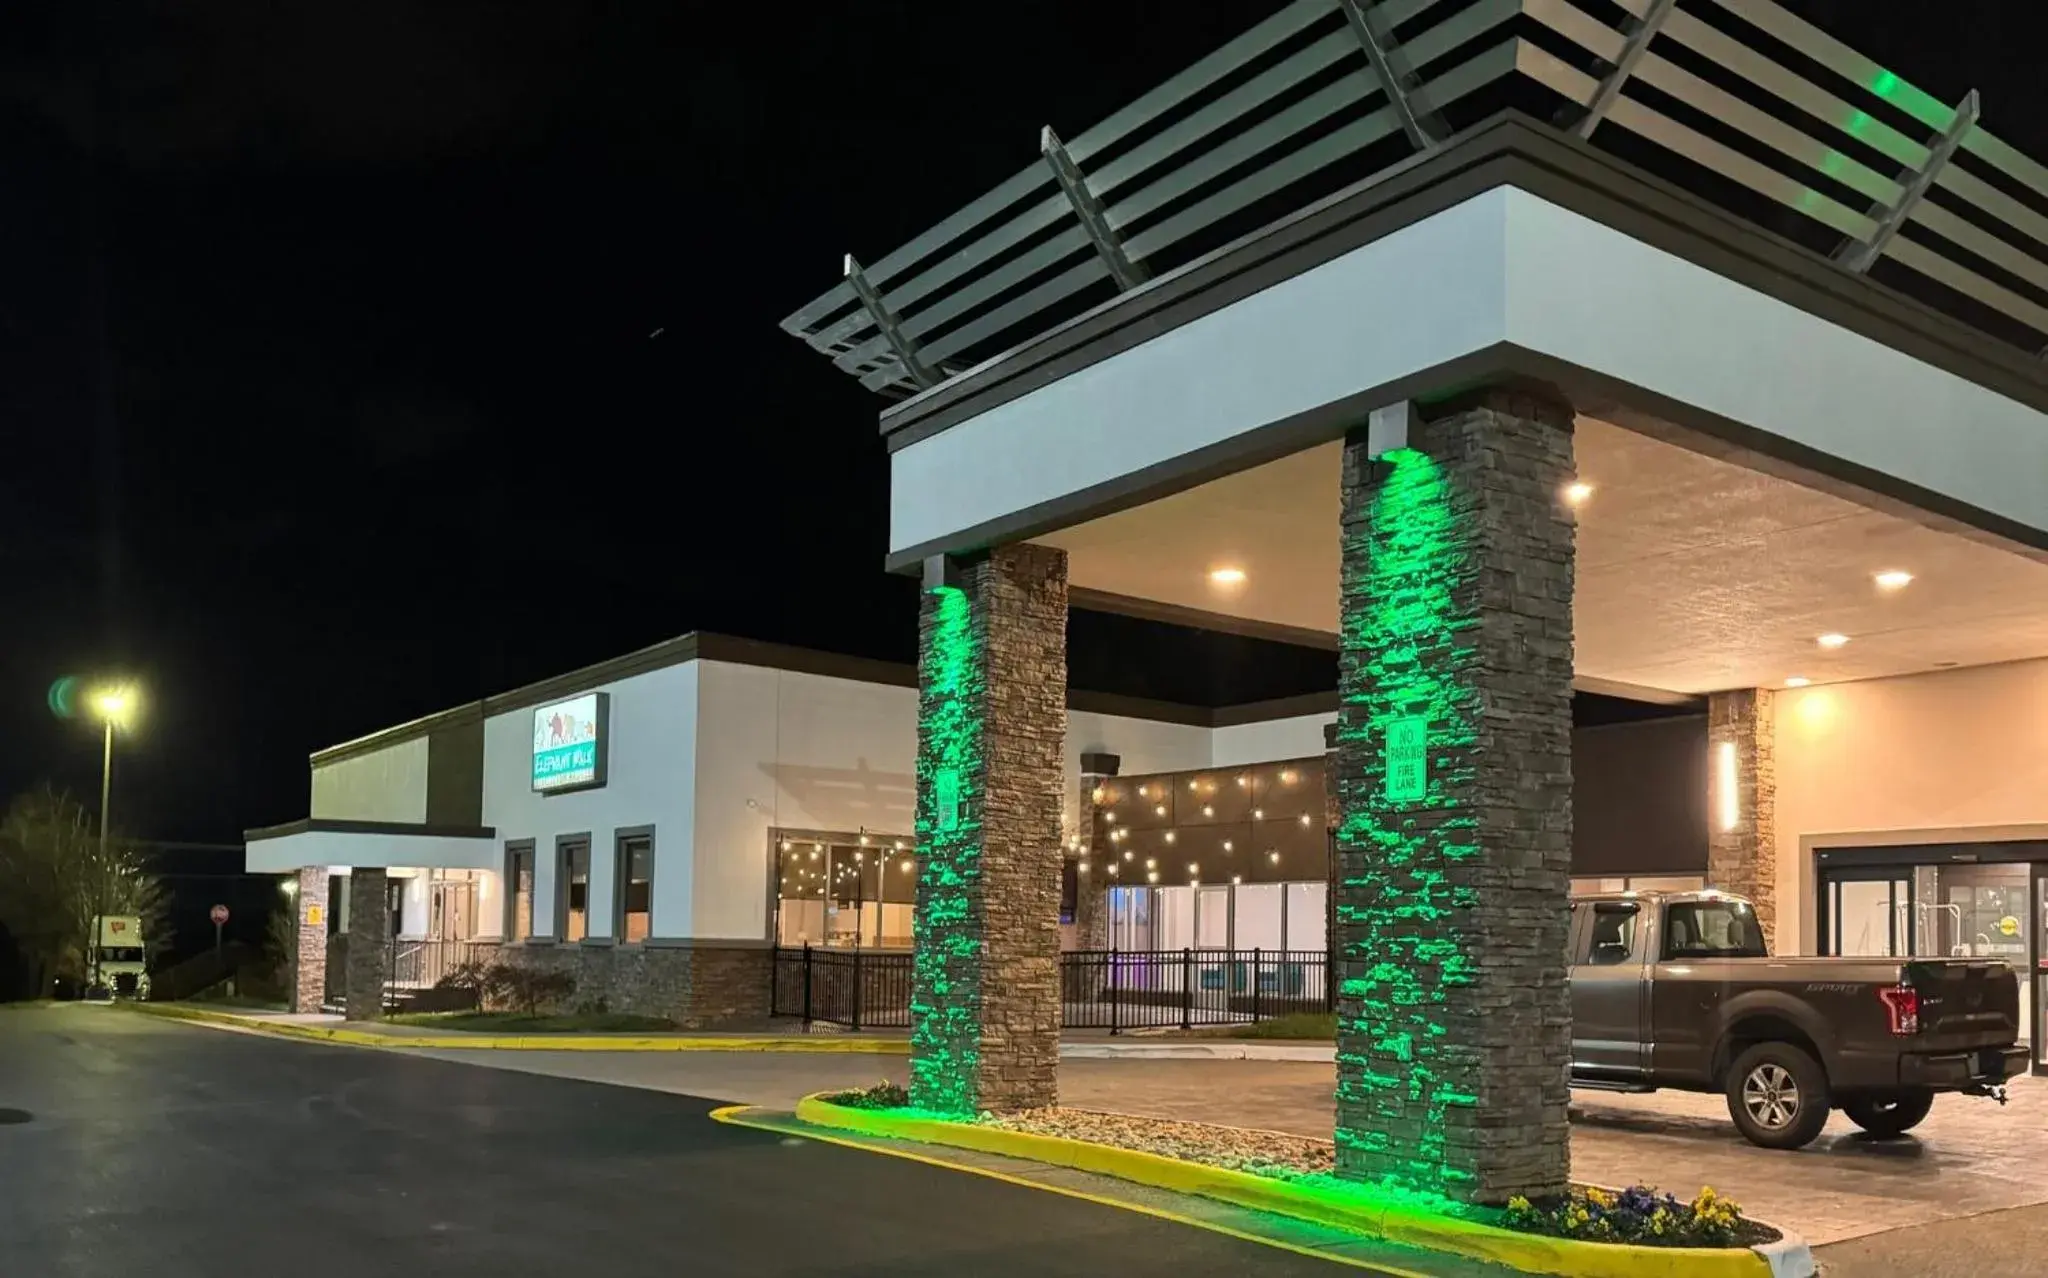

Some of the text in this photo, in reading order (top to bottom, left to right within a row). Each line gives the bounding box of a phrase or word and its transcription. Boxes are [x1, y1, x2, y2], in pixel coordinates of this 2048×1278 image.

[1400, 727, 1414, 743] NO
[1398, 764, 1415, 777] FIRE
[1396, 777, 1416, 791] LANE
